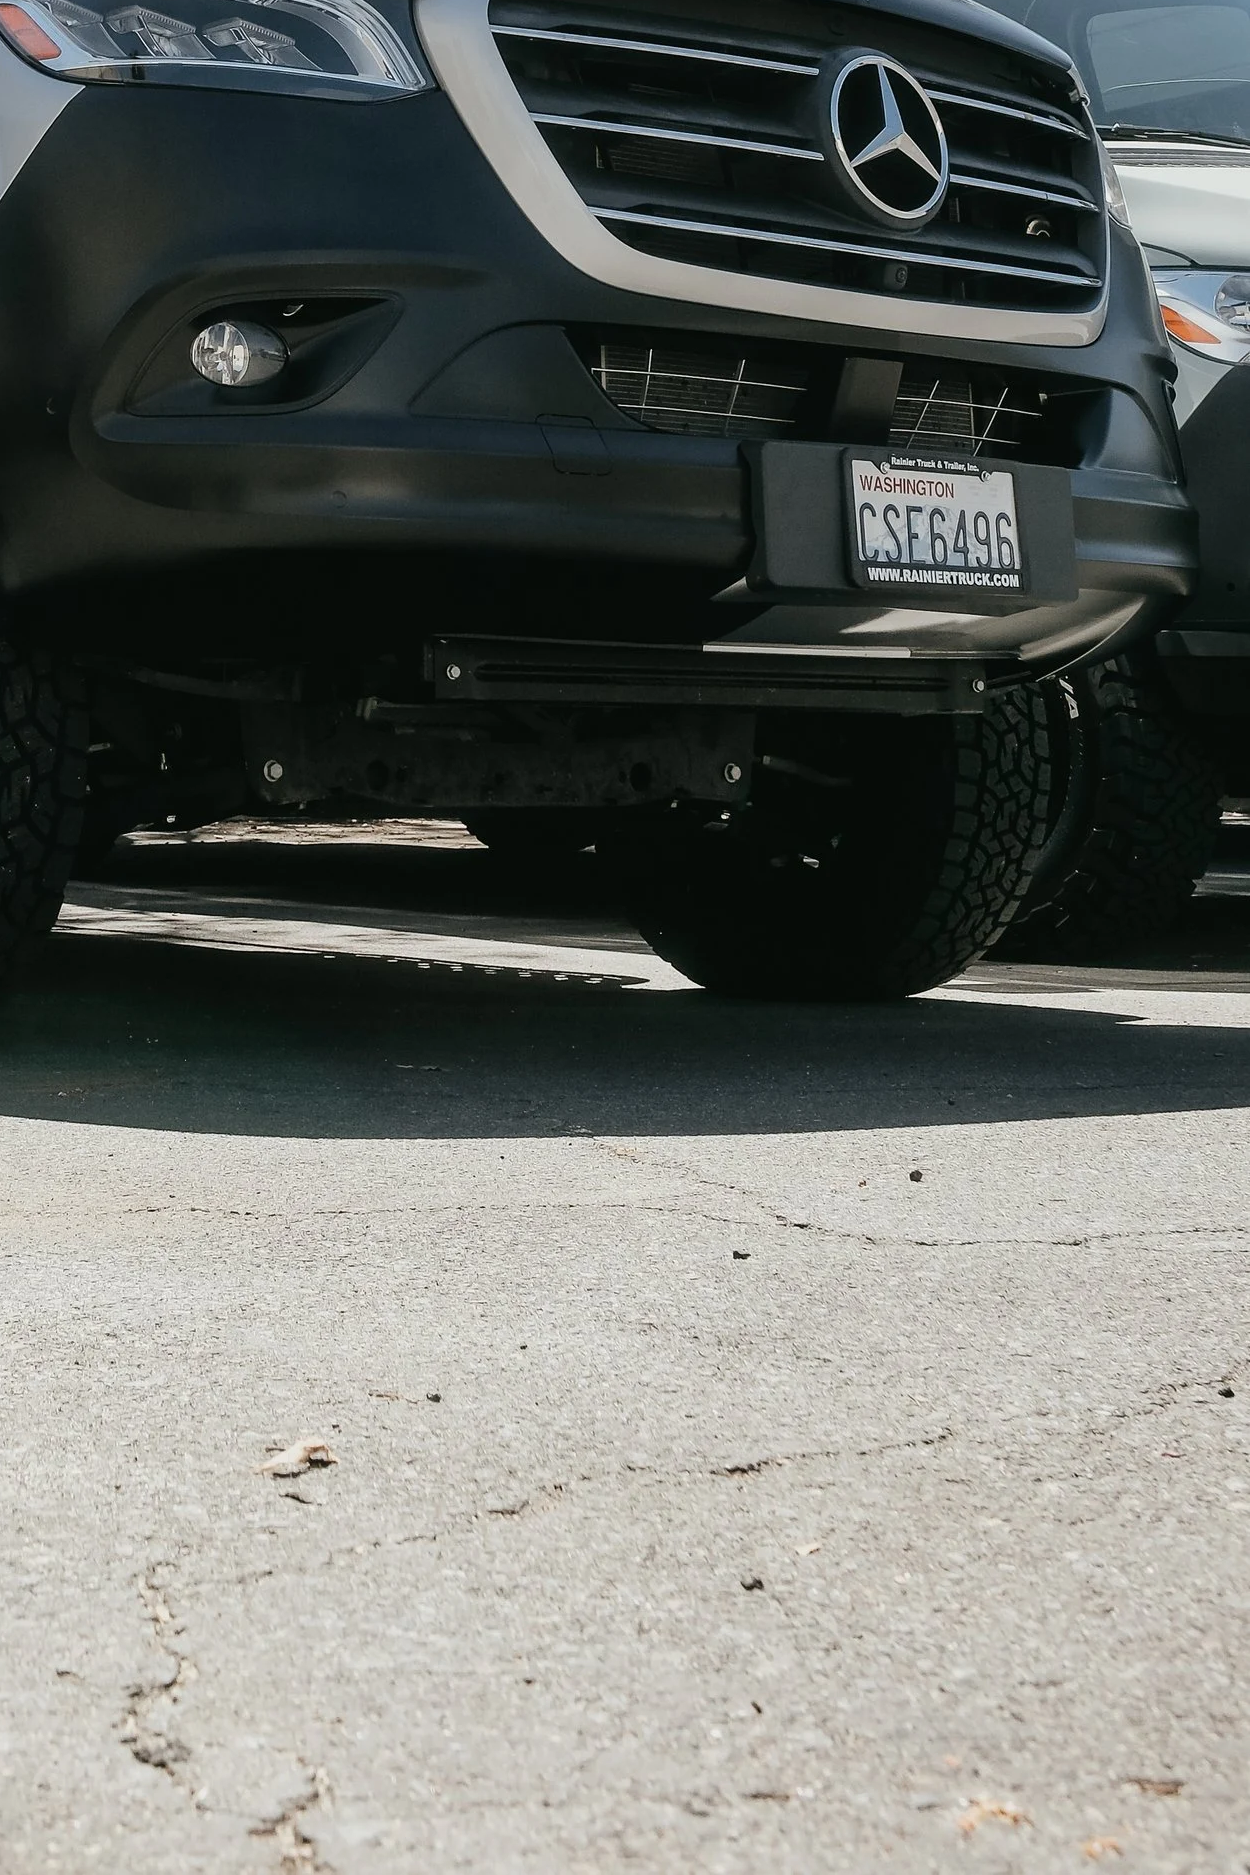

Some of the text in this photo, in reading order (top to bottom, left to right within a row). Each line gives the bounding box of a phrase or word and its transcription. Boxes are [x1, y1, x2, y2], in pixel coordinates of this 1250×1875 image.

[891, 456, 916, 466] Rainier
[916, 459, 936, 468] Truck
[937, 460, 943, 469] &
[967, 463, 980, 472] Inc.
[859, 474, 955, 498] WASHINGTON
[859, 502, 1015, 569] CSE6496
[867, 567, 1020, 588] WWW.RAINIERTRUCK.COM
